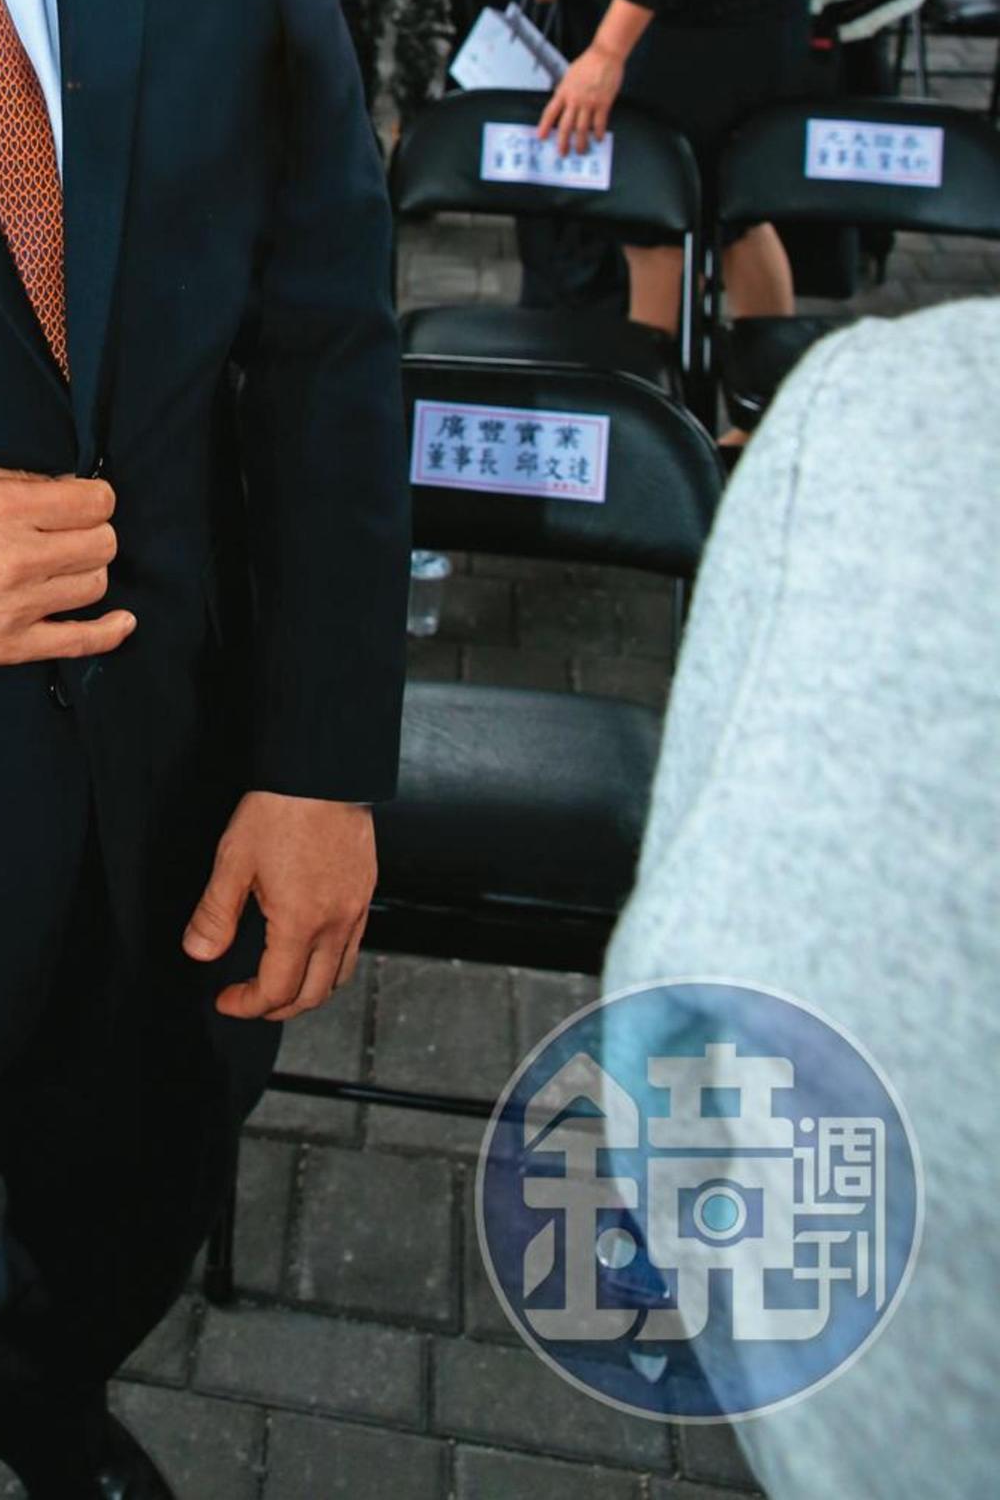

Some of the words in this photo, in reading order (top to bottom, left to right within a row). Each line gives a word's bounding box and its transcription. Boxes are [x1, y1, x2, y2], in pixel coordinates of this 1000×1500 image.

[436, 414, 583, 450] 廣豐實業
[426, 442, 500, 476] 董事長
